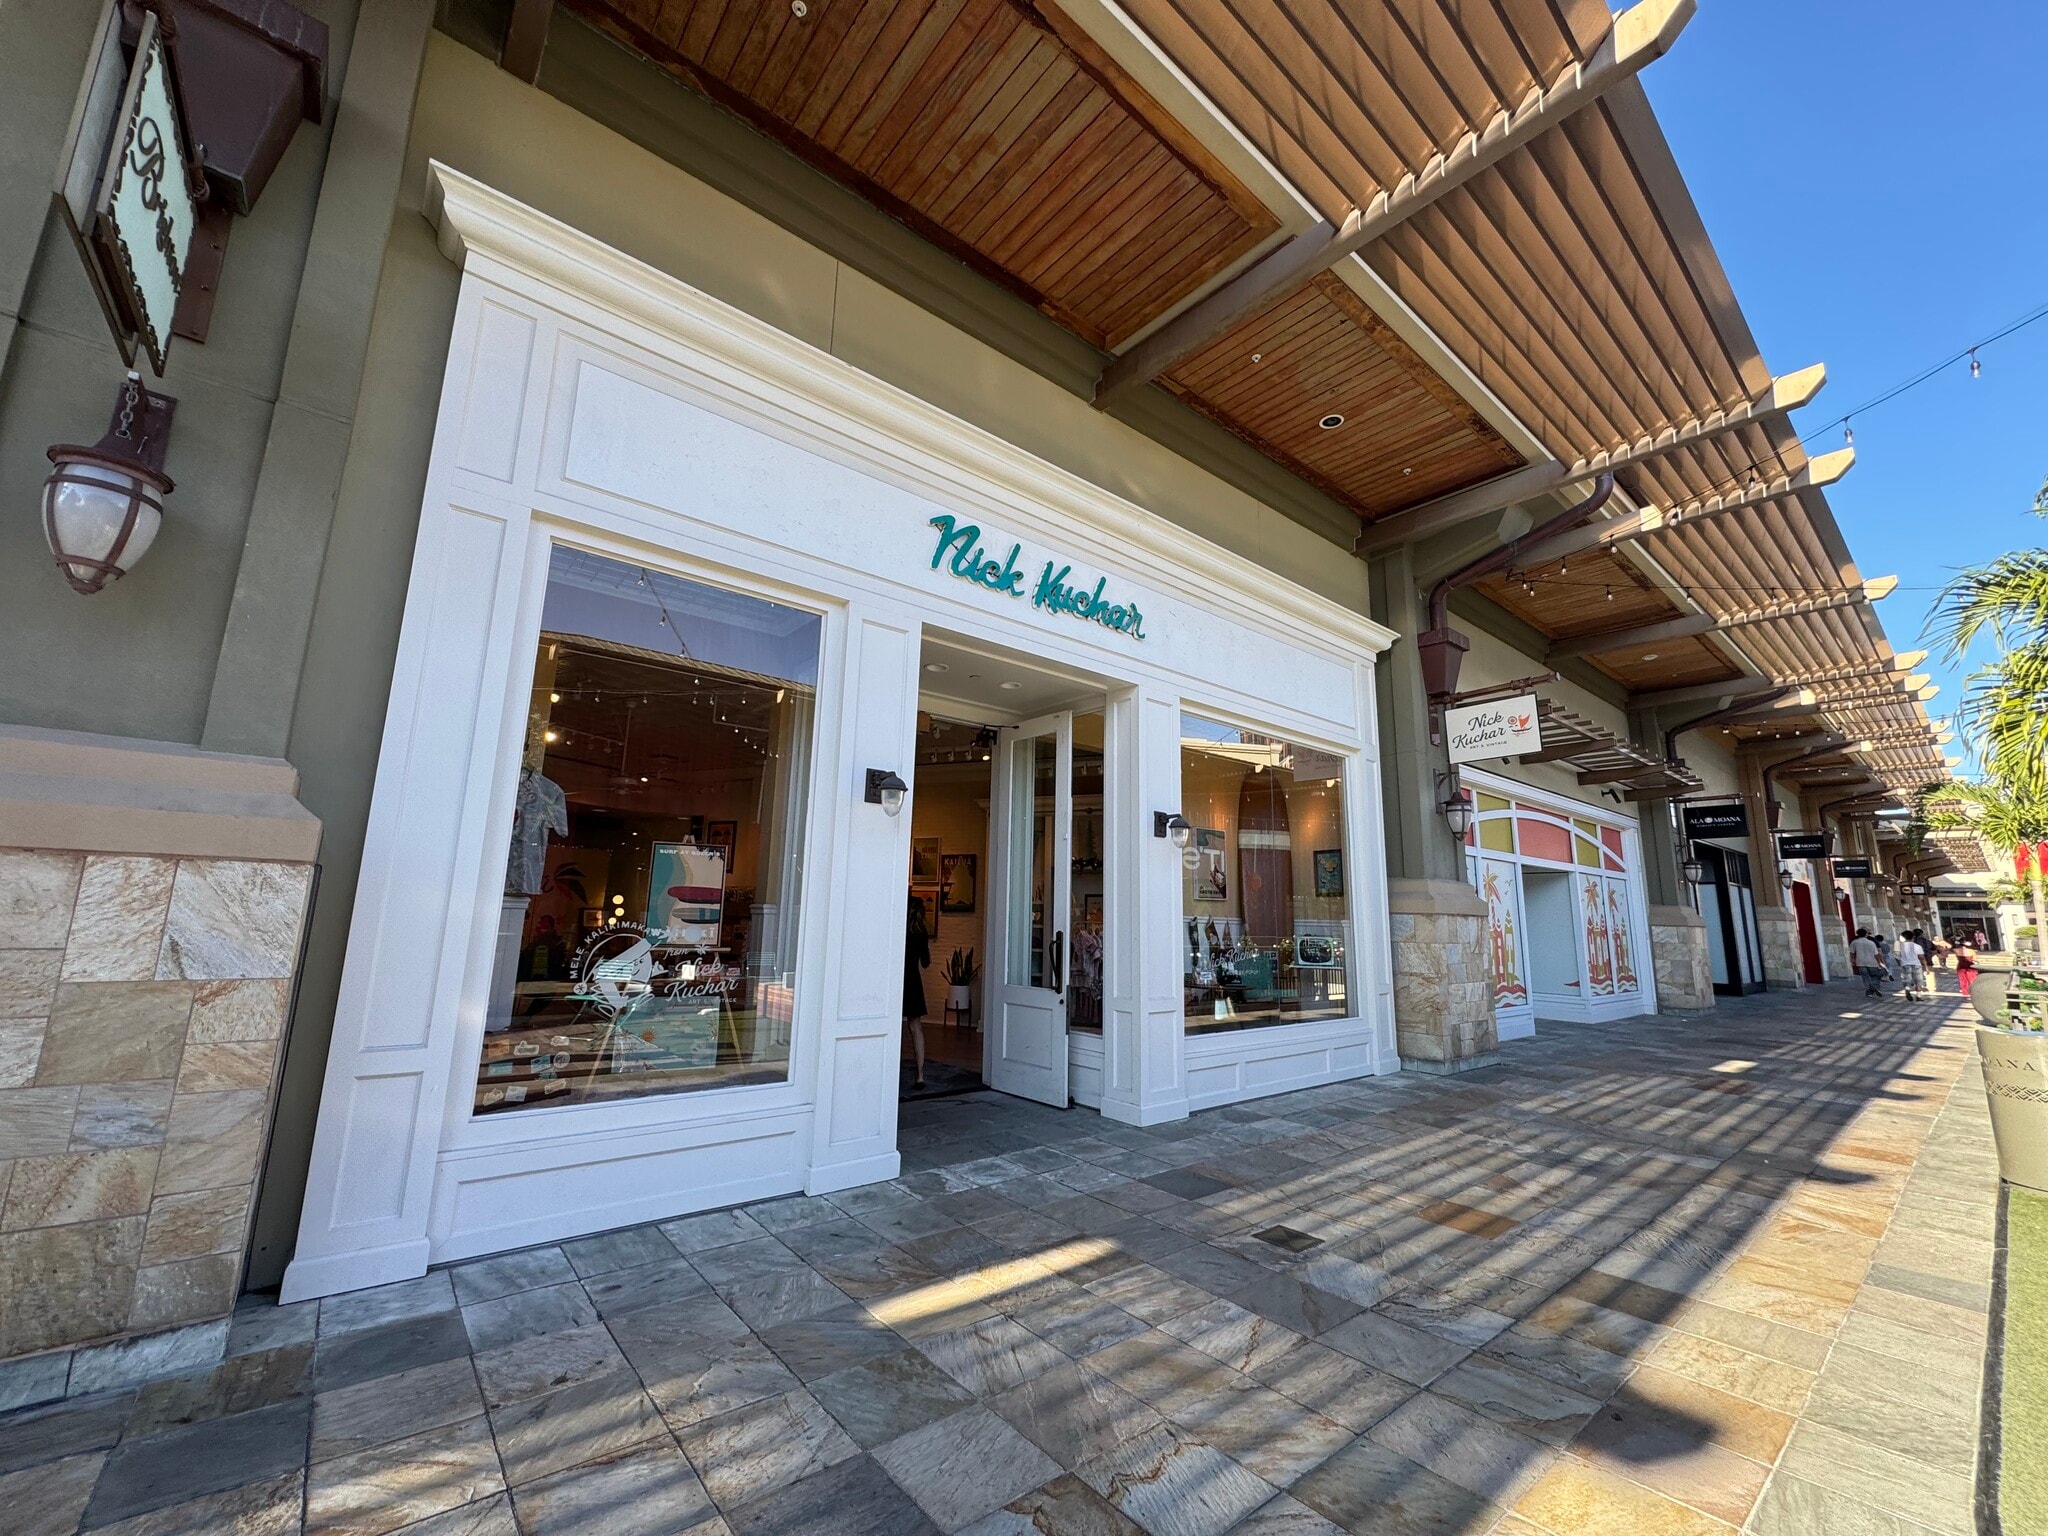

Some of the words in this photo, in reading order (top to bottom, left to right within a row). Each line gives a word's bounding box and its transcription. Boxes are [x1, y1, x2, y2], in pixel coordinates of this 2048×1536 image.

[928, 514, 1026, 598] Nick
[1031, 560, 1146, 641] Kuchar
[1468, 711, 1504, 731] Nick
[1452, 727, 1506, 749] Kuchar
[569, 946, 585, 979] MELE
[663, 947, 690, 960] from
[664, 977, 739, 1002] Kuchar
